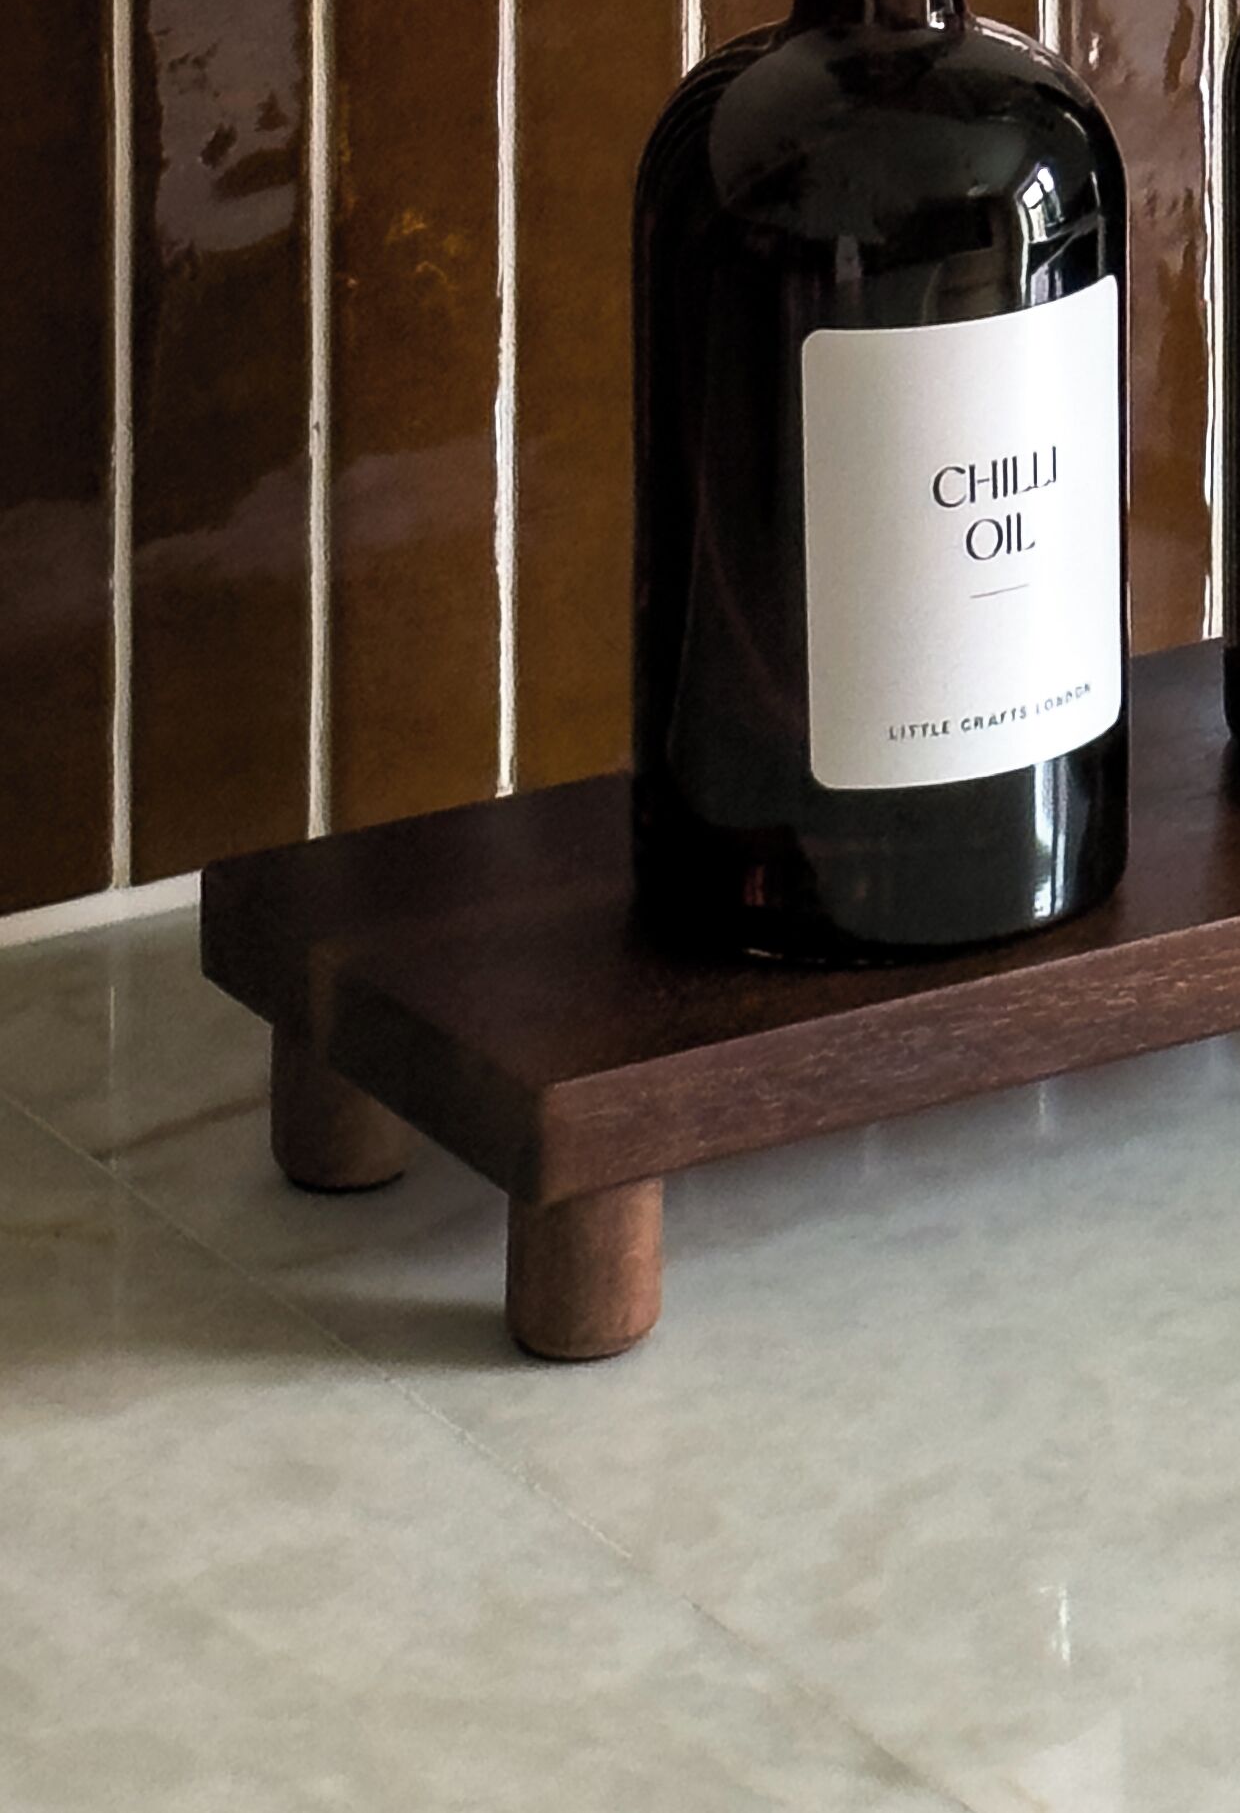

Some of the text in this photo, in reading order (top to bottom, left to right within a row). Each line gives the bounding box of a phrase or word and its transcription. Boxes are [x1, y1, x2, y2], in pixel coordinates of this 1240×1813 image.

[932, 445, 1056, 508] CHILLI
[966, 512, 1035, 560] OIL
[889, 720, 951, 740] LITTLE
[960, 705, 1027, 732] CRAFTS
